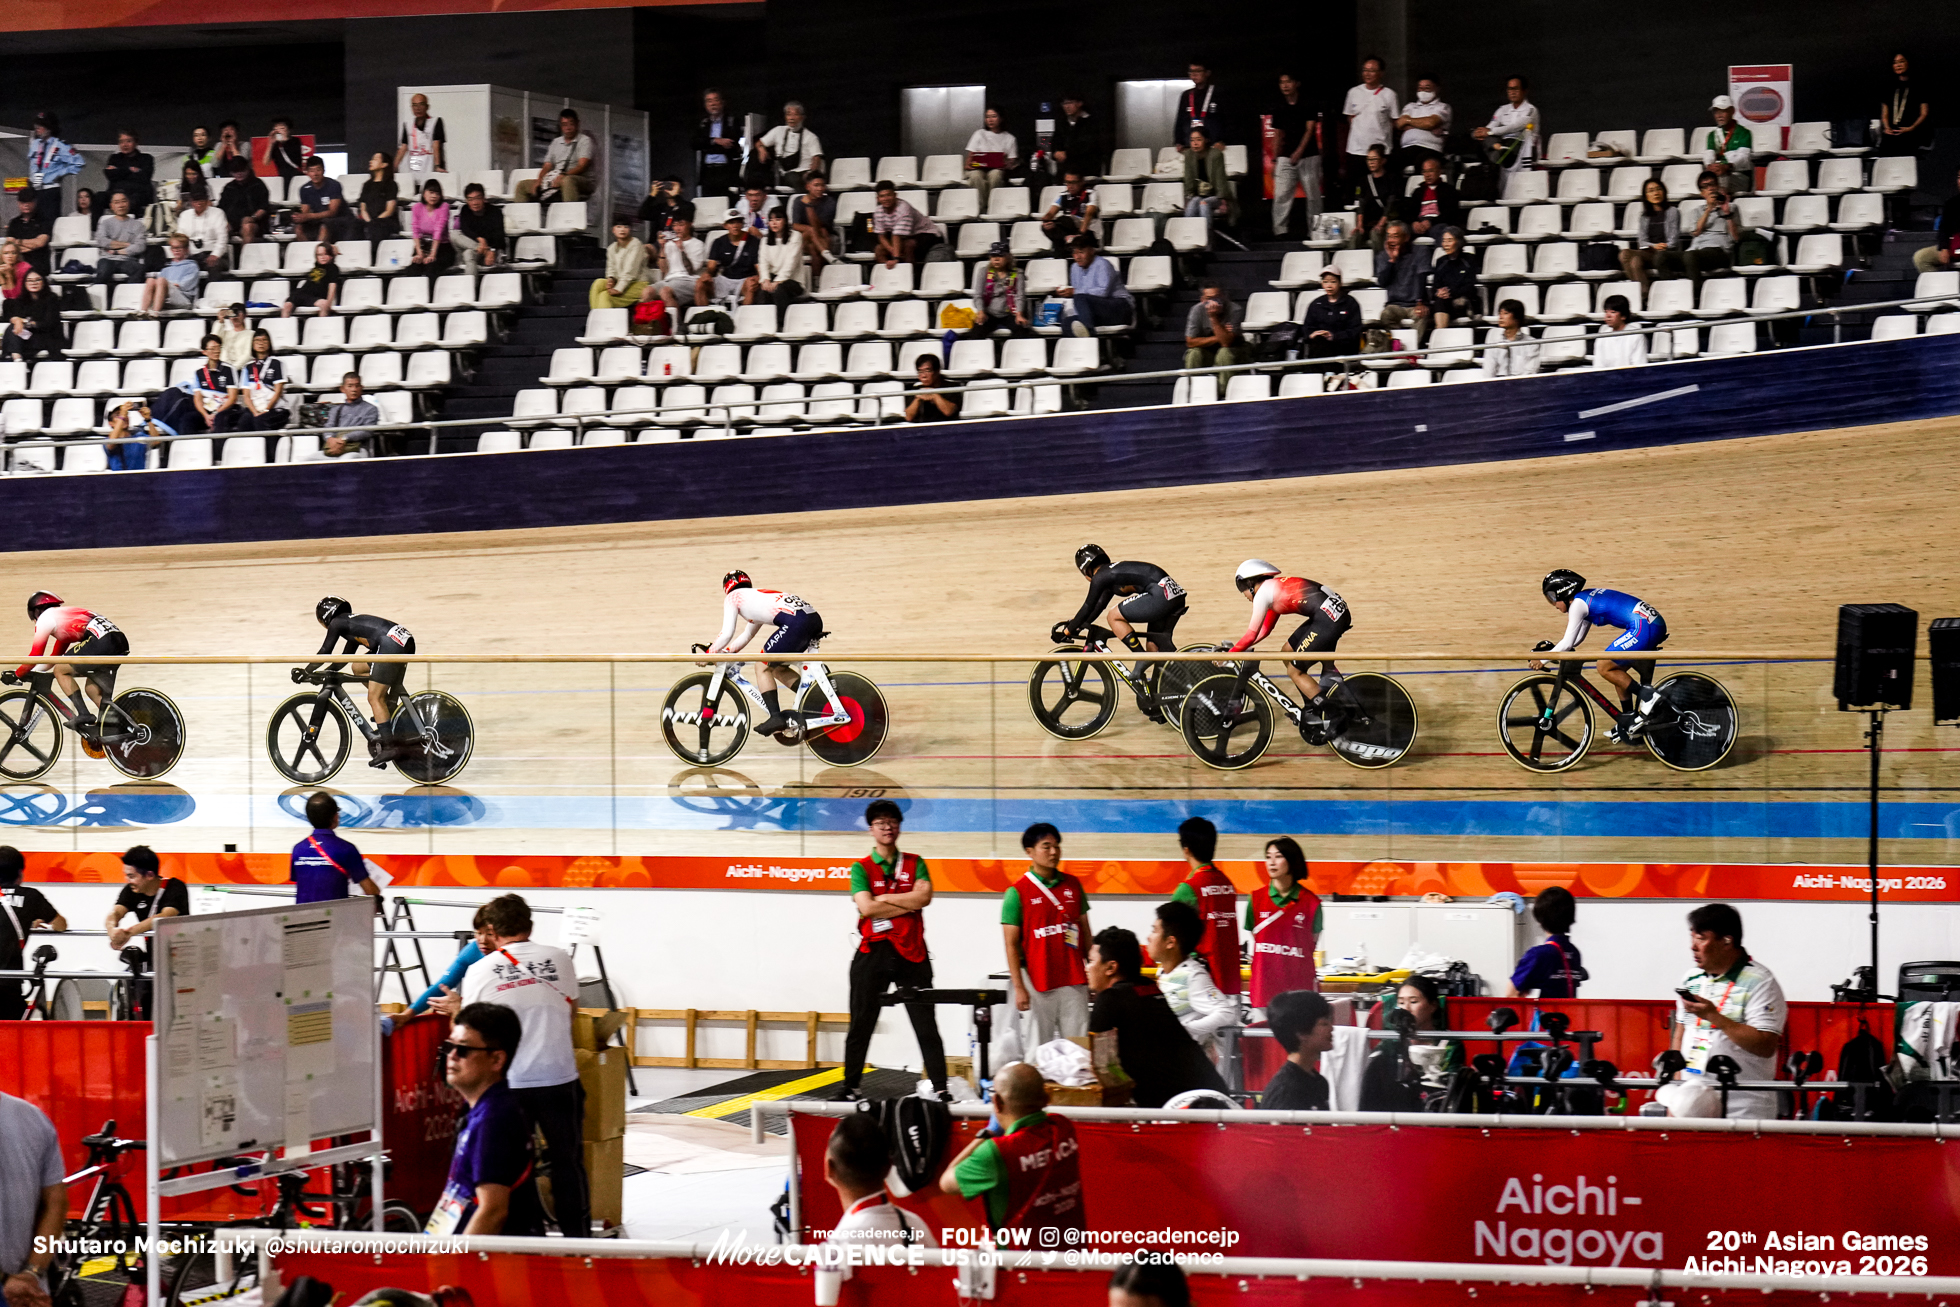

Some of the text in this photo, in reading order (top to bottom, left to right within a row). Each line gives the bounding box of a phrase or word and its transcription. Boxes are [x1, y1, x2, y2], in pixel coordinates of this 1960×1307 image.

[766, 624, 789, 651] JAPAN
[1251, 671, 1302, 722] KOGA
[725, 864, 826, 882] Aichi-Nagoya
[1904, 876, 1947, 890] 2026
[1255, 942, 1305, 958] MEDICAL
[1495, 1173, 1643, 1216] Aichi-
[1474, 1220, 1665, 1268] Nagoya
